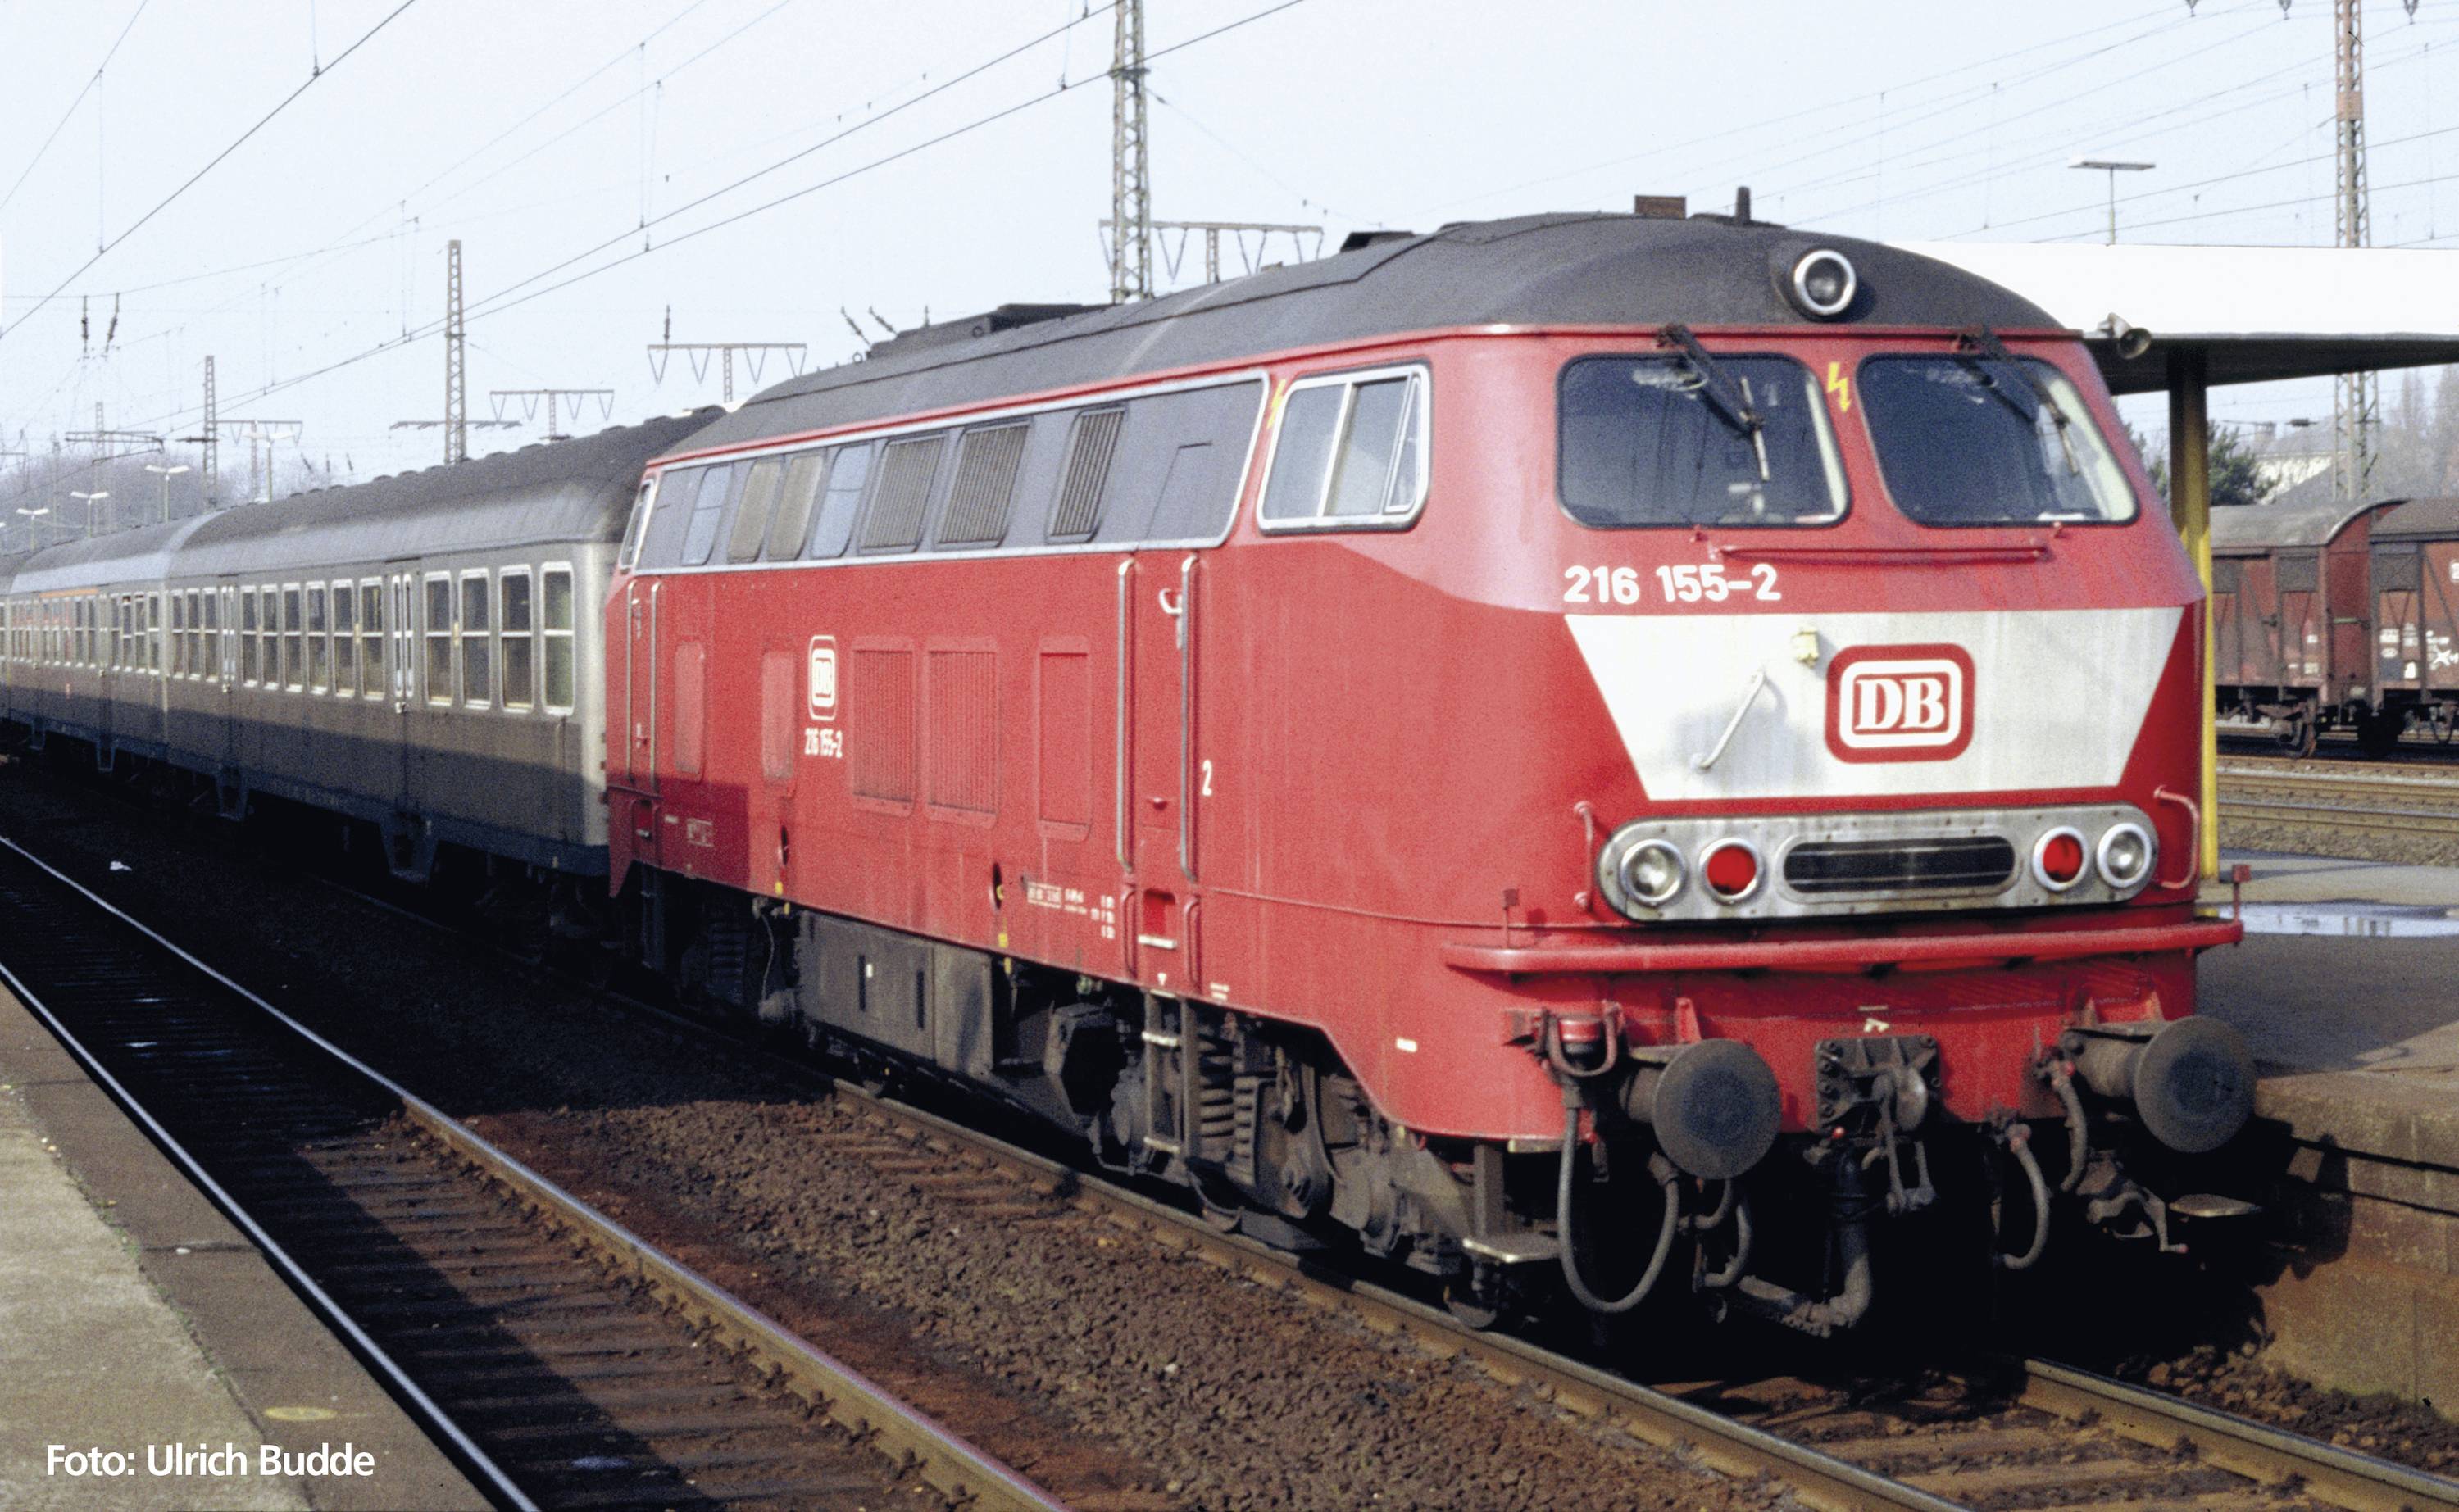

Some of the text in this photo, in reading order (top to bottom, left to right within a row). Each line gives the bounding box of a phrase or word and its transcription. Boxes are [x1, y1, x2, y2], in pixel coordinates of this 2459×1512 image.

[1563, 563, 1782, 605] 216 155-2
[1854, 677, 1945, 730] DB
[1202, 759, 1212, 797] 2
